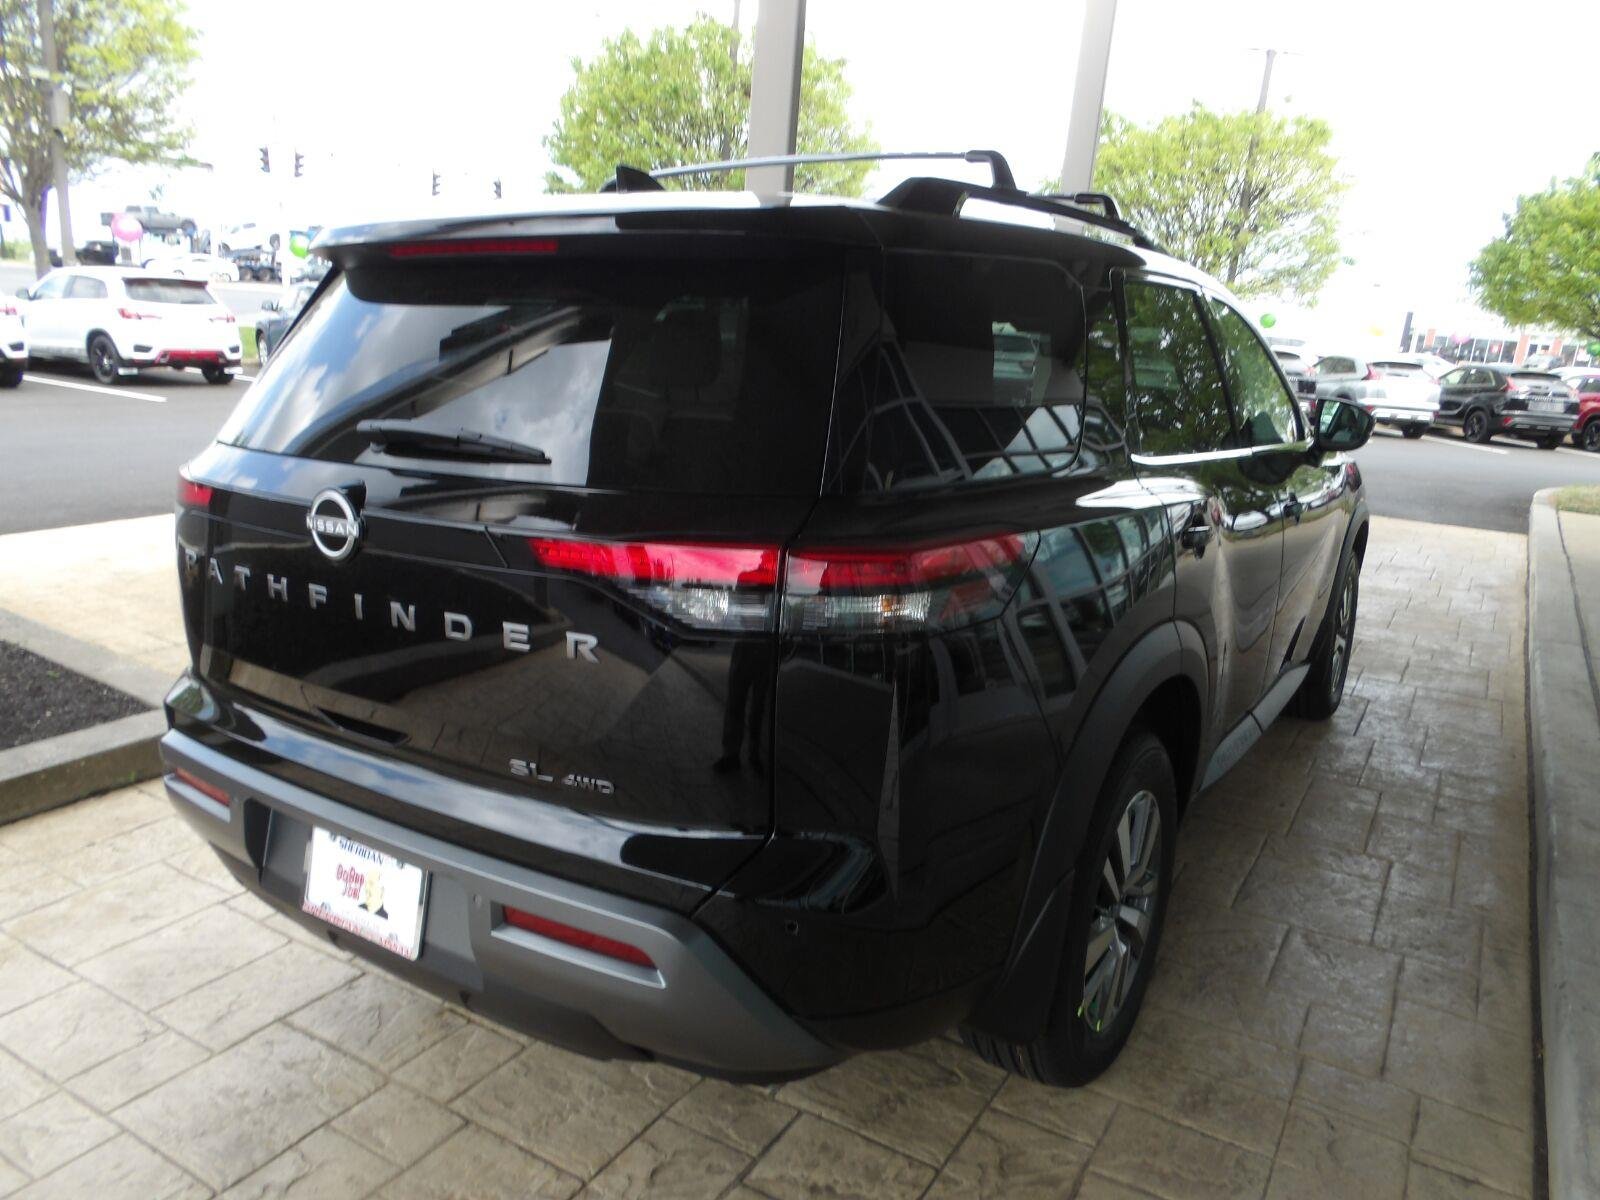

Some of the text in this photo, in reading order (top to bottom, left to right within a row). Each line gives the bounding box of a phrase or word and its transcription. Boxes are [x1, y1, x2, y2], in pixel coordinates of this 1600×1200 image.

[306, 514, 359, 539] NISSAN
[183, 548, 599, 664] PATHFINDER
[508, 758, 615, 795] SL 4WD
